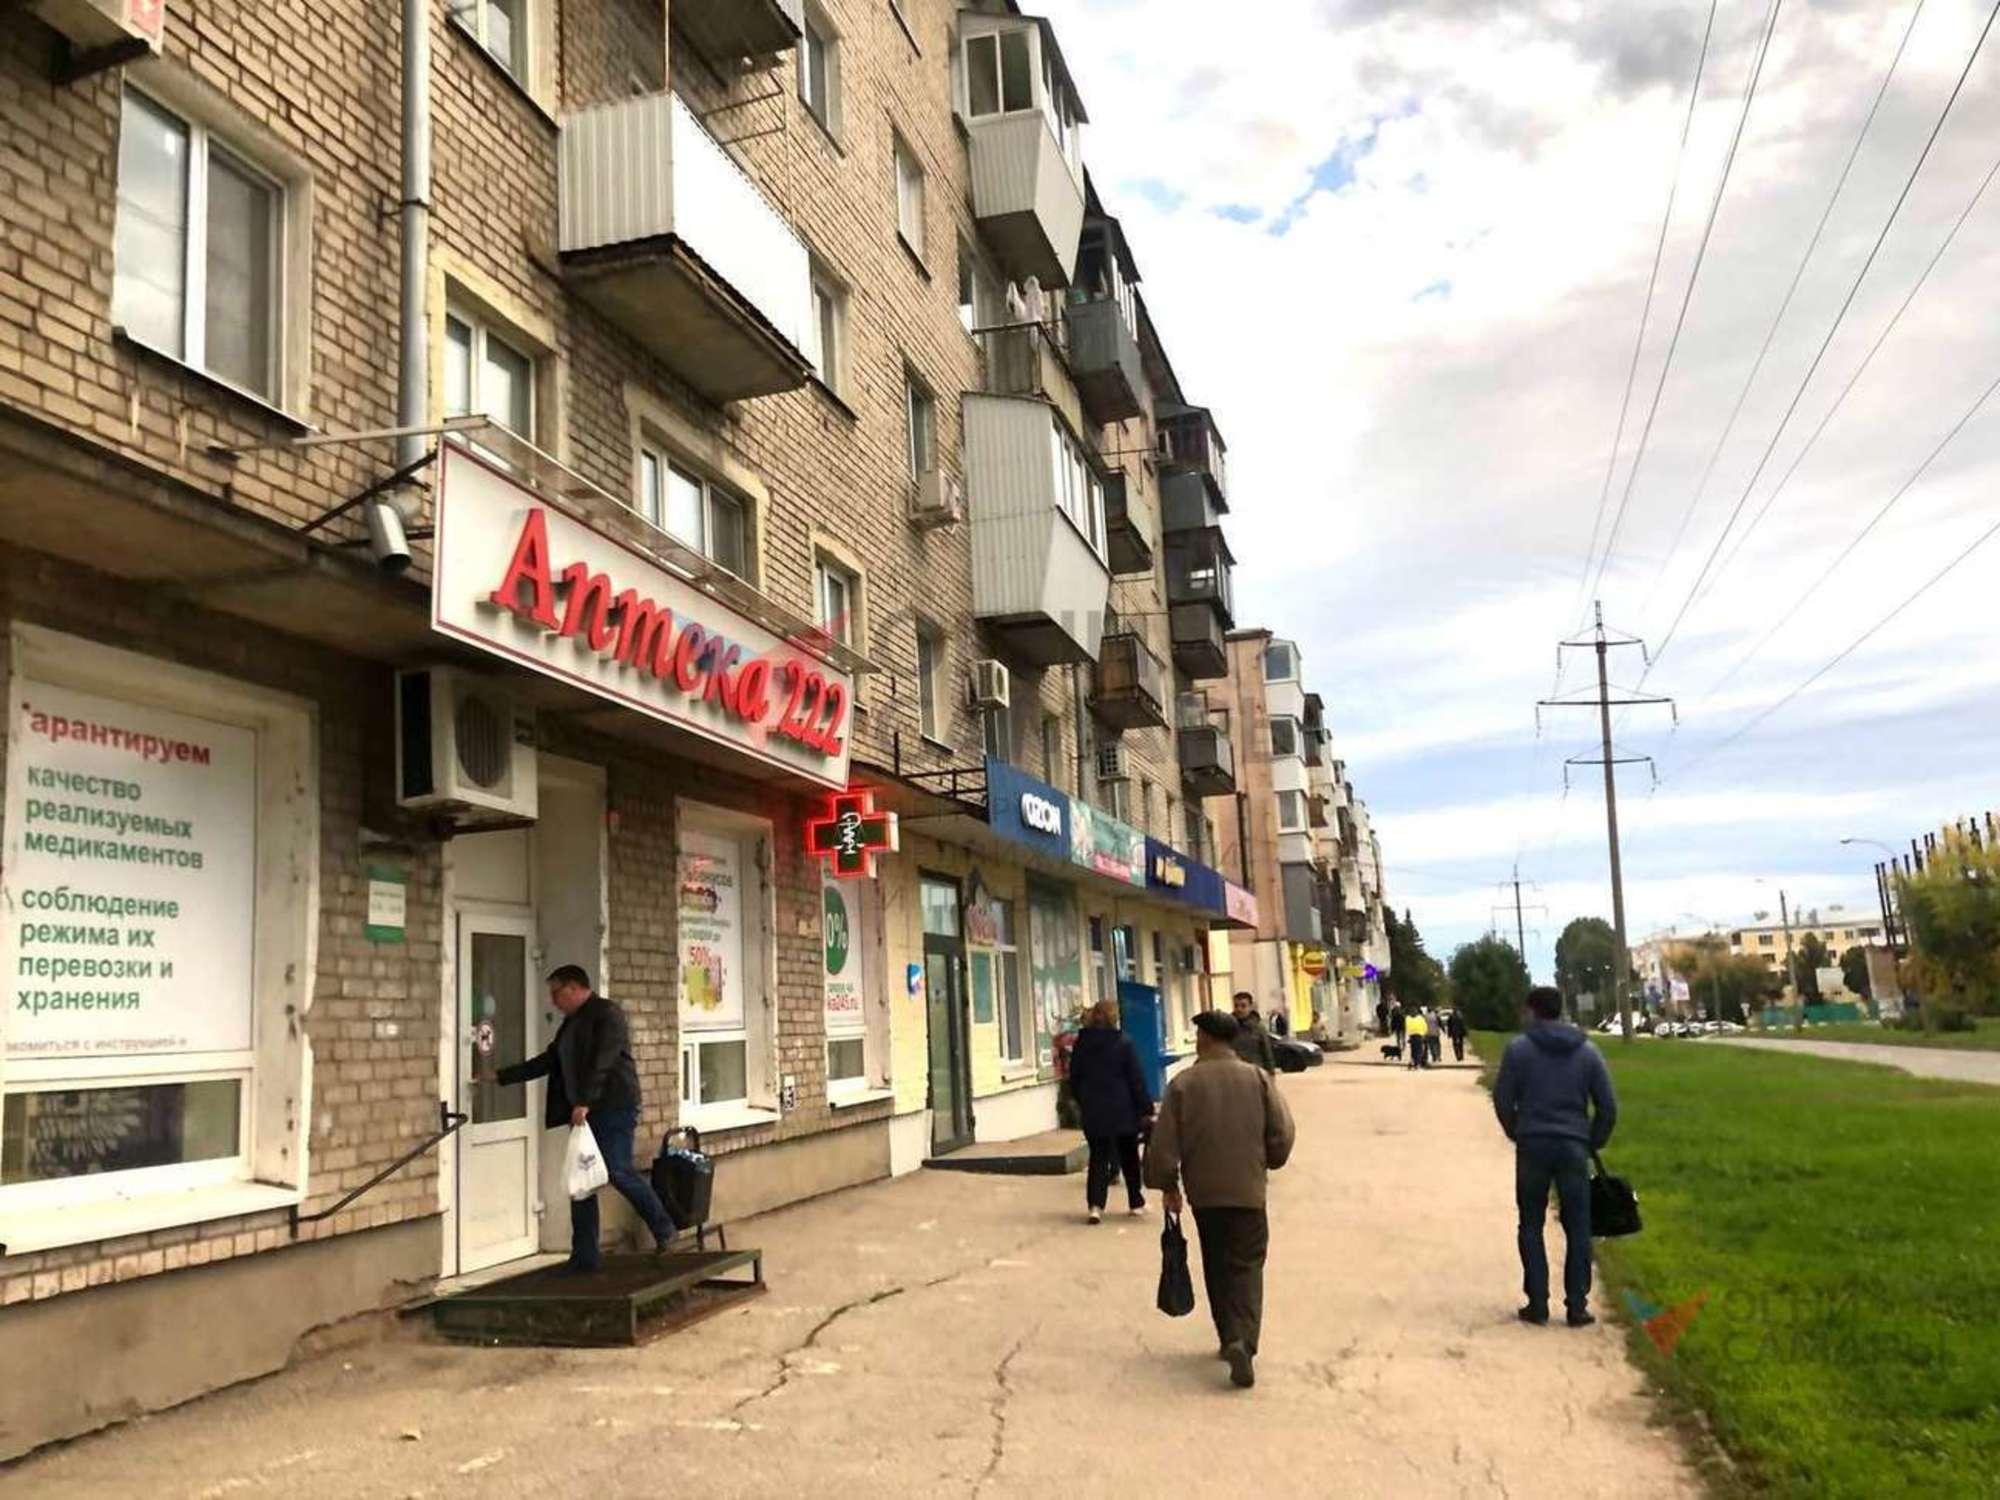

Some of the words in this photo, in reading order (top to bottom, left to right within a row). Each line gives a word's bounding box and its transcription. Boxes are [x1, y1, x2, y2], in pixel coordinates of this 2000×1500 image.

[490, 508, 769, 723] Аптека
[778, 659, 845, 757] 222
[22, 702, 211, 765] арантируем
[27, 765, 142, 801] качество
[25, 800, 193, 840] реализуемых
[1021, 793, 1061, 836] OZON
[24, 833, 203, 870] медикаментов
[21, 887, 180, 919] соблюдение
[20, 921, 119, 949] режима
[126, 928, 155, 949] их
[18, 955, 153, 984] перевозки
[159, 962, 174, 979] и
[17, 988, 140, 1013] хранения
